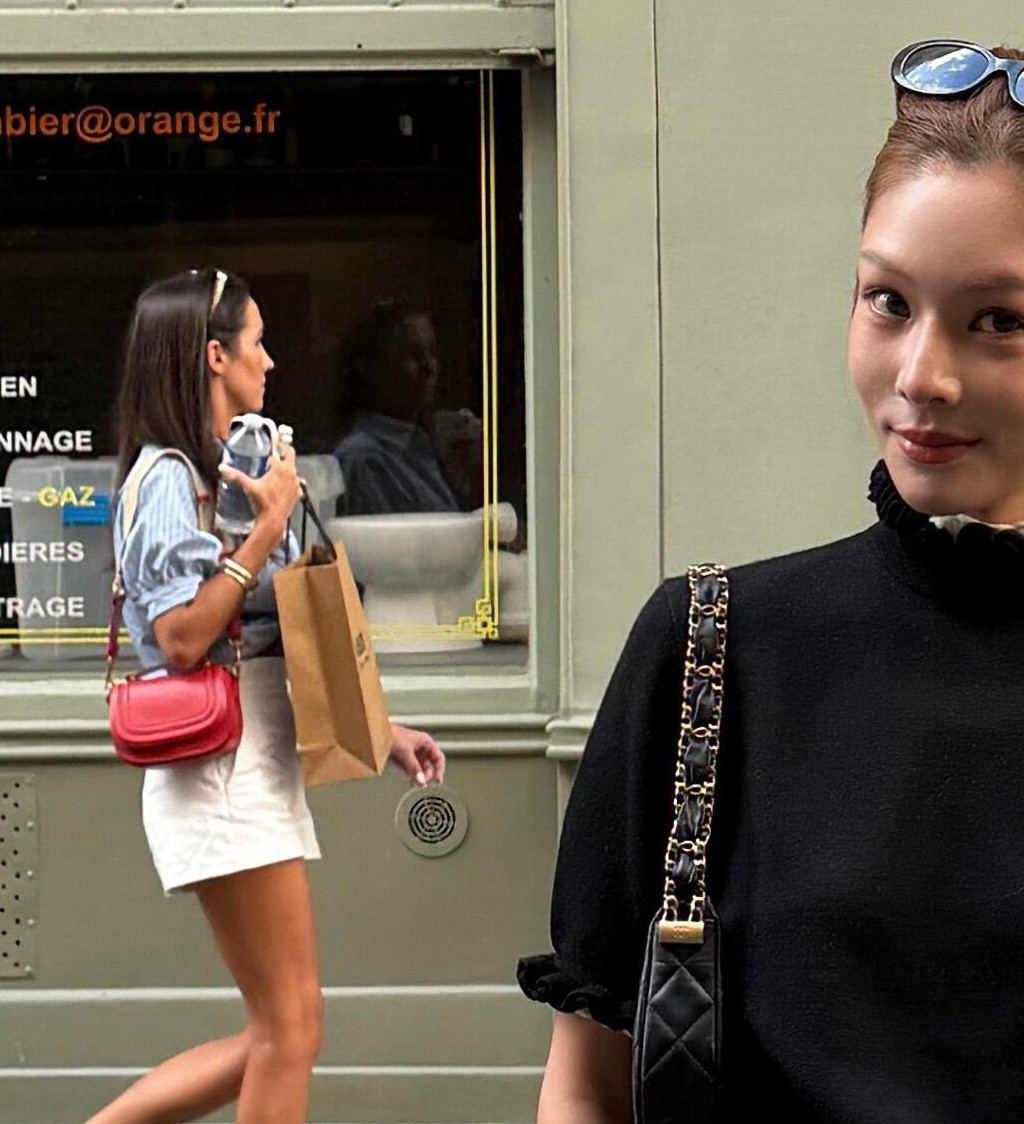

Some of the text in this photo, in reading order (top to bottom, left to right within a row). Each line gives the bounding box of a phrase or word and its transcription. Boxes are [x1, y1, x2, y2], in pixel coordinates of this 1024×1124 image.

[0, 103, 280, 143] bier@orange.fr
[1, 376, 37, 397] EN
[0, 430, 93, 453] NNAGE
[38, 486, 96, 507] GAZ
[0, 542, 85, 563] IERES
